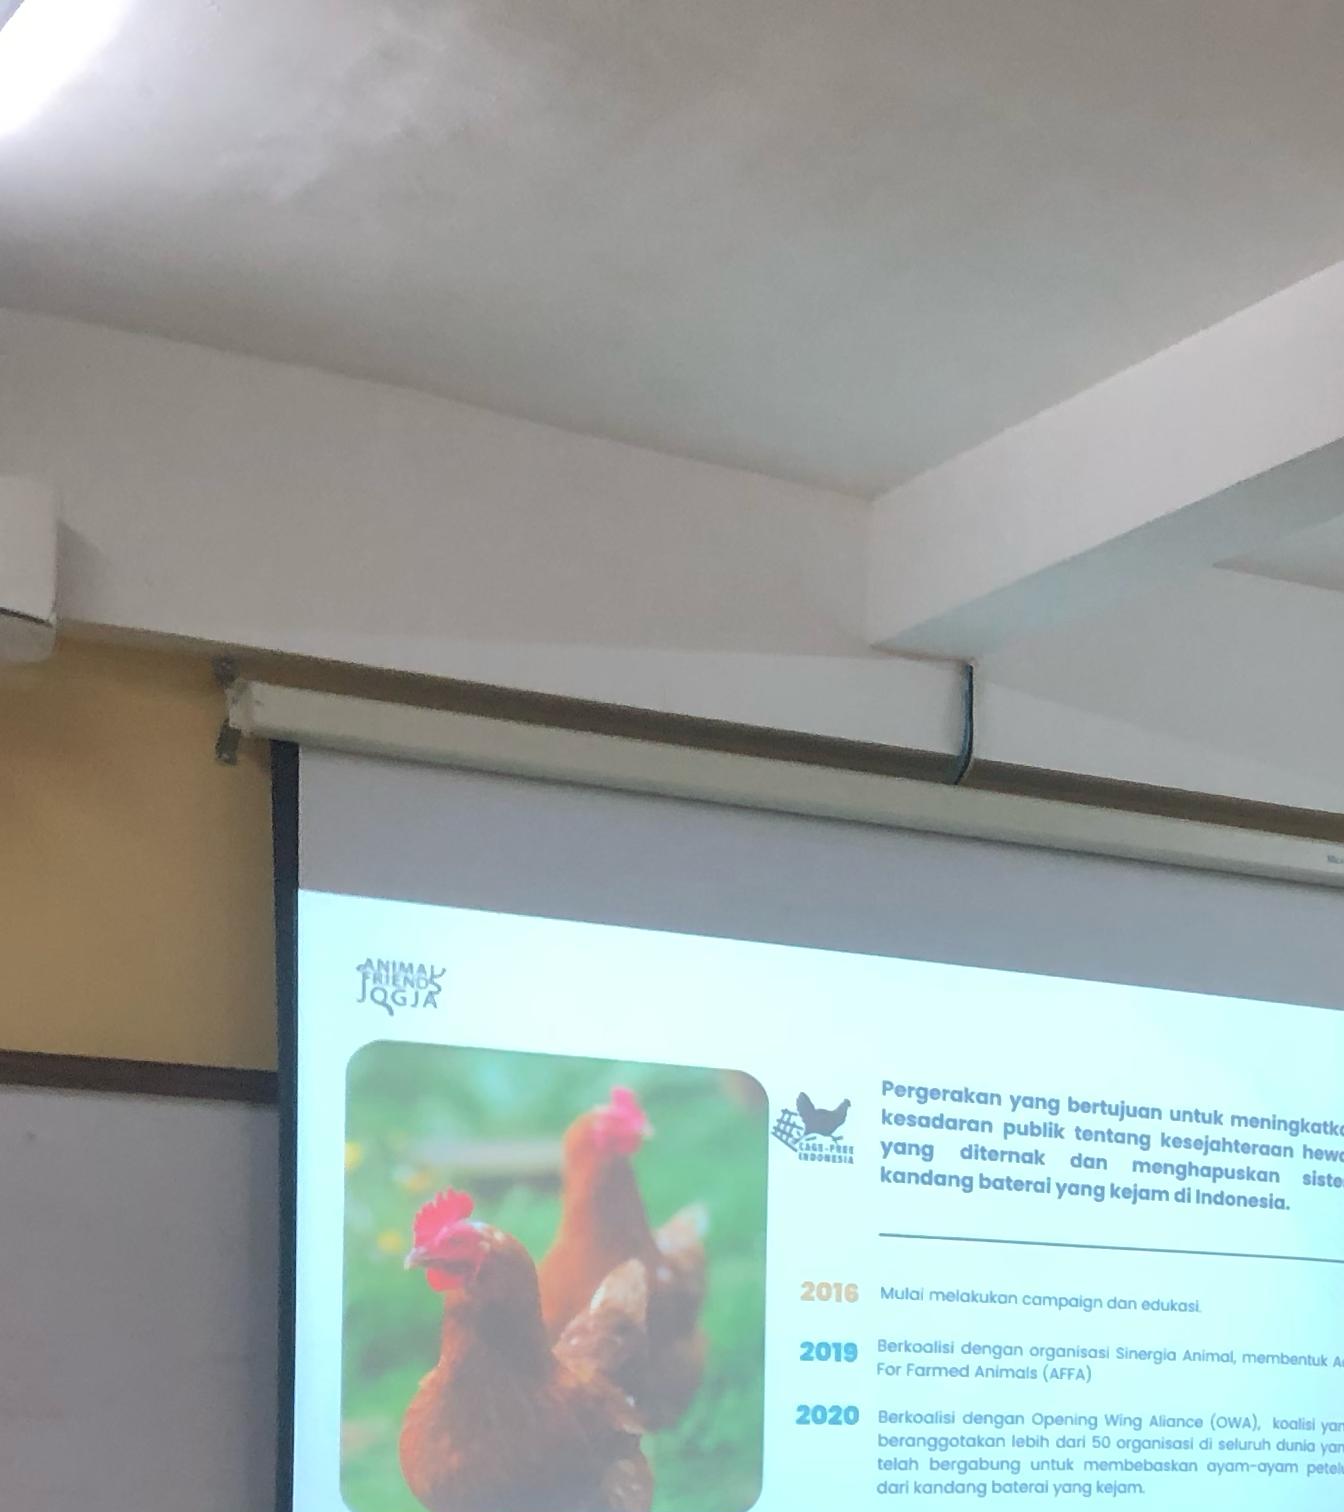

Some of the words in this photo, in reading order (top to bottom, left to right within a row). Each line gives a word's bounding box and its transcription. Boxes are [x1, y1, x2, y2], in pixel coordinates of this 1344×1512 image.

[882, 1080, 1001, 1105] Pergerakan
[1010, 1094, 1060, 1115] yang
[1068, 1097, 1162, 1122] bertujuan
[1170, 1108, 1223, 1125] untuk
[882, 1109, 993, 1133] kesadaran
[1004, 1121, 1065, 1139] publik
[1075, 1125, 1150, 1151] tentang
[1161, 1132, 1294, 1158] kesejahteraan
[881, 1140, 934, 1161] yang
[960, 1144, 1045, 1165] diternak
[1070, 1153, 1107, 1170] dan
[1132, 1159, 1280, 1183] menghapuskan
[881, 1166, 973, 1193] kandang
[1056, 1181, 1105, 1202] yang
[1110, 1183, 1169, 1204] kejam
[1174, 1187, 1191, 1203] di
[1196, 1190, 1290, 1210] Indonesia.
[800, 1281, 859, 1303] 2016
[881, 1286, 923, 1300] Mulai
[930, 1289, 1018, 1304] melakukan
[1022, 1293, 1102, 1312] campaign
[1107, 1296, 1137, 1310] dan
[800, 1341, 858, 1362] 2019
[877, 1339, 954, 1354] Berkoalisi
[961, 1342, 1023, 1359] dengan
[1030, 1347, 1109, 1361] organisasi
[1116, 1347, 1176, 1364] Sinergia
[1182, 1349, 1237, 1365] Animal,
[1242, 1352, 1328, 1367] membentuk
[877, 1363, 901, 1376] For
[907, 1364, 969, 1377] Farmed
[975, 1366, 1038, 1379] Animals
[1043, 1365, 1091, 1383] (AFFA)
[796, 1405, 859, 1425] 2020
[878, 1410, 955, 1424] Berkoalisi
[963, 1412, 1024, 1429] dengan
[1032, 1412, 1097, 1430] Opening
[1105, 1413, 1142, 1431] Wing
[1149, 1414, 1203, 1428] Aliance
[1273, 1417, 1315, 1431] koalisi
[878, 1434, 1005, 1451] beranggotakan
[1012, 1435, 1049, 1448] lebih
[1056, 1435, 1085, 1448] dari
[1092, 1436, 1111, 1449] 50
[1117, 1437, 1194, 1453] organisasi
[1199, 1437, 1212, 1450] di
[1219, 1438, 1271, 1451] seluruh
[1276, 1439, 1315, 1452] dunia
[877, 1457, 919, 1470] telah
[930, 1458, 1020, 1475] bergabung
[1031, 1458, 1073, 1471] untuk
[1084, 1458, 1197, 1472] membebaskan
[1207, 1461, 1298, 1476] ayam-ayam
[877, 1481, 908, 1494] dari
[914, 1481, 987, 1497] kandang
[992, 1481, 1048, 1494] baterai
[1053, 1483, 1092, 1497] yang
[1096, 1480, 1145, 1497] kejam.
